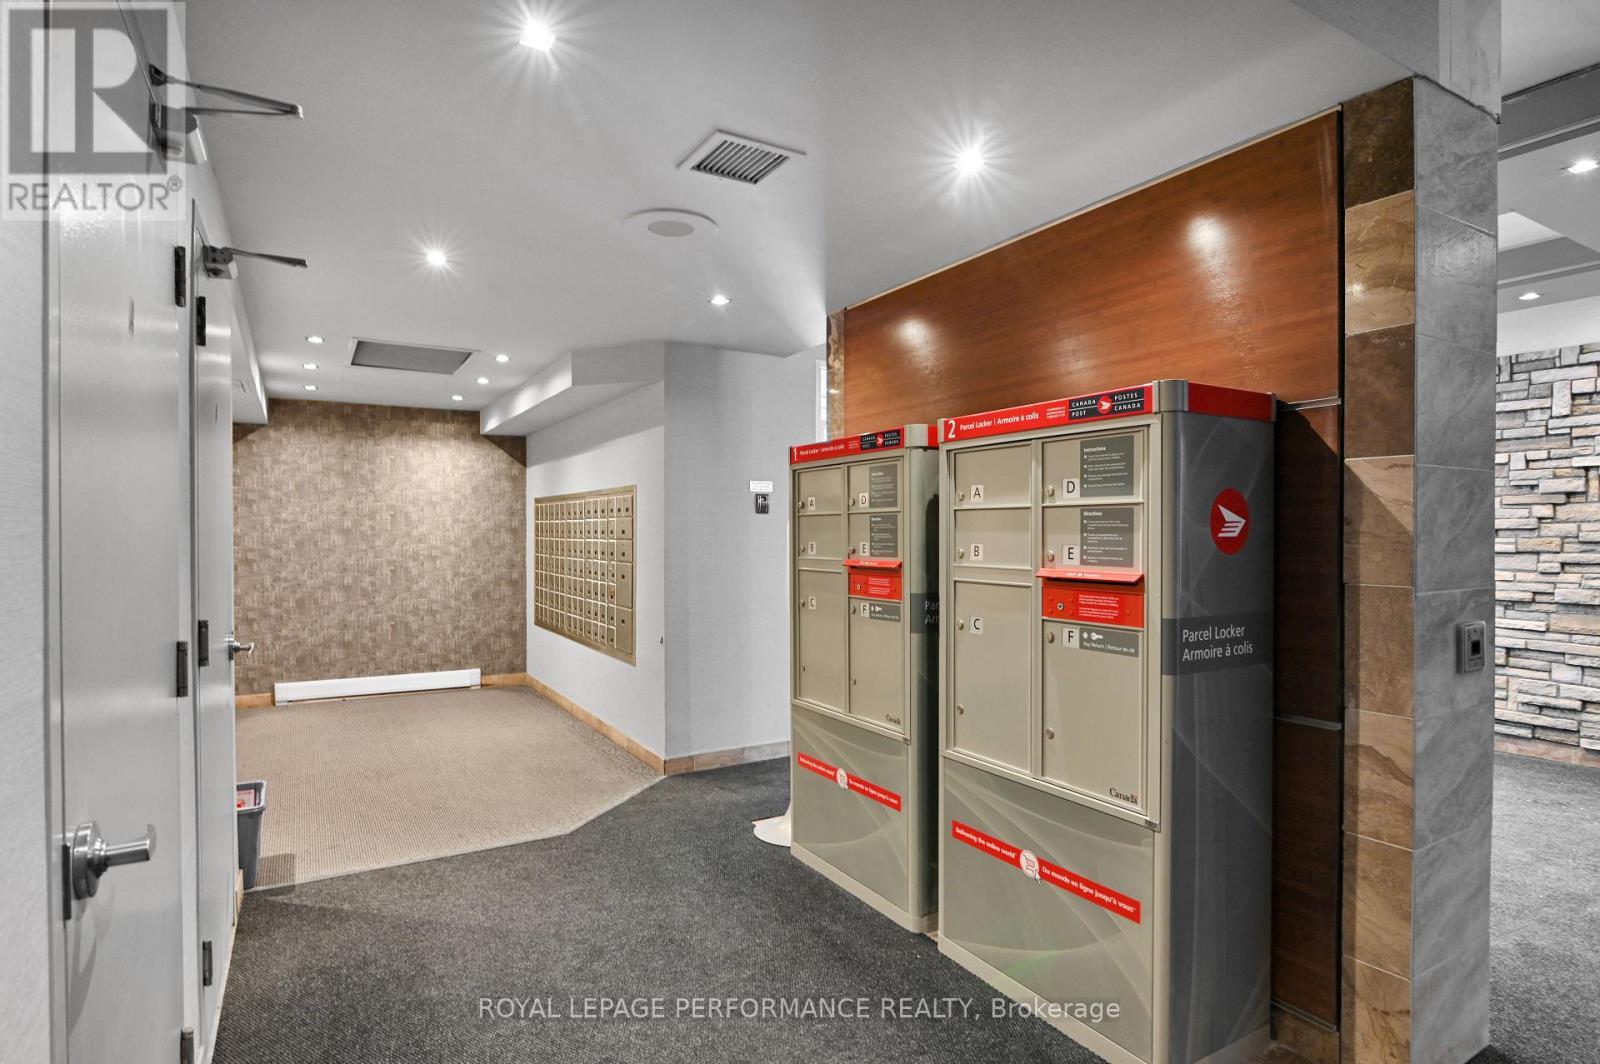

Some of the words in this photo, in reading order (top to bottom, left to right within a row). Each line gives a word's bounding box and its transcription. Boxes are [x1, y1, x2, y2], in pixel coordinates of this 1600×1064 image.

[1114, 392, 1138, 401] POSTES
[1072, 399, 1096, 408] CANADA
[1114, 402, 1141, 411] CANADA
[960, 422, 975, 431] Parcel
[976, 419, 993, 429] Locker
[997, 415, 1020, 425] Armoire
[1025, 412, 1039, 420] colis
[948, 419, 956, 439] 2
[793, 447, 797, 461] 1
[1066, 480, 1076, 493] D
[974, 487, 981, 498] A
[809, 499, 814, 507] A
[861, 495, 867, 504] D
[810, 543, 814, 552] B
[862, 543, 867, 553] E
[974, 545, 980, 557] B
[1067, 547, 1075, 560] E
[810, 598, 815, 607] C
[924, 600, 939, 611] Par
[862, 604, 867, 614] F
[973, 618, 980, 630] C
[1068, 630, 1074, 643] F
[1182, 626, 1212, 643] Parcel
[1215, 624, 1245, 640] Locker
[1182, 644, 1223, 661] Armoire
[1225, 642, 1231, 656] à
[1233, 640, 1253, 655] colis
[1109, 787, 1138, 805] Canada
[977, 836, 986, 845] the
[1042, 866, 1051, 875] Du
[1050, 870, 1070, 884] monde
[1070, 880, 1079, 888] en
[1079, 882, 1094, 894] ligne
